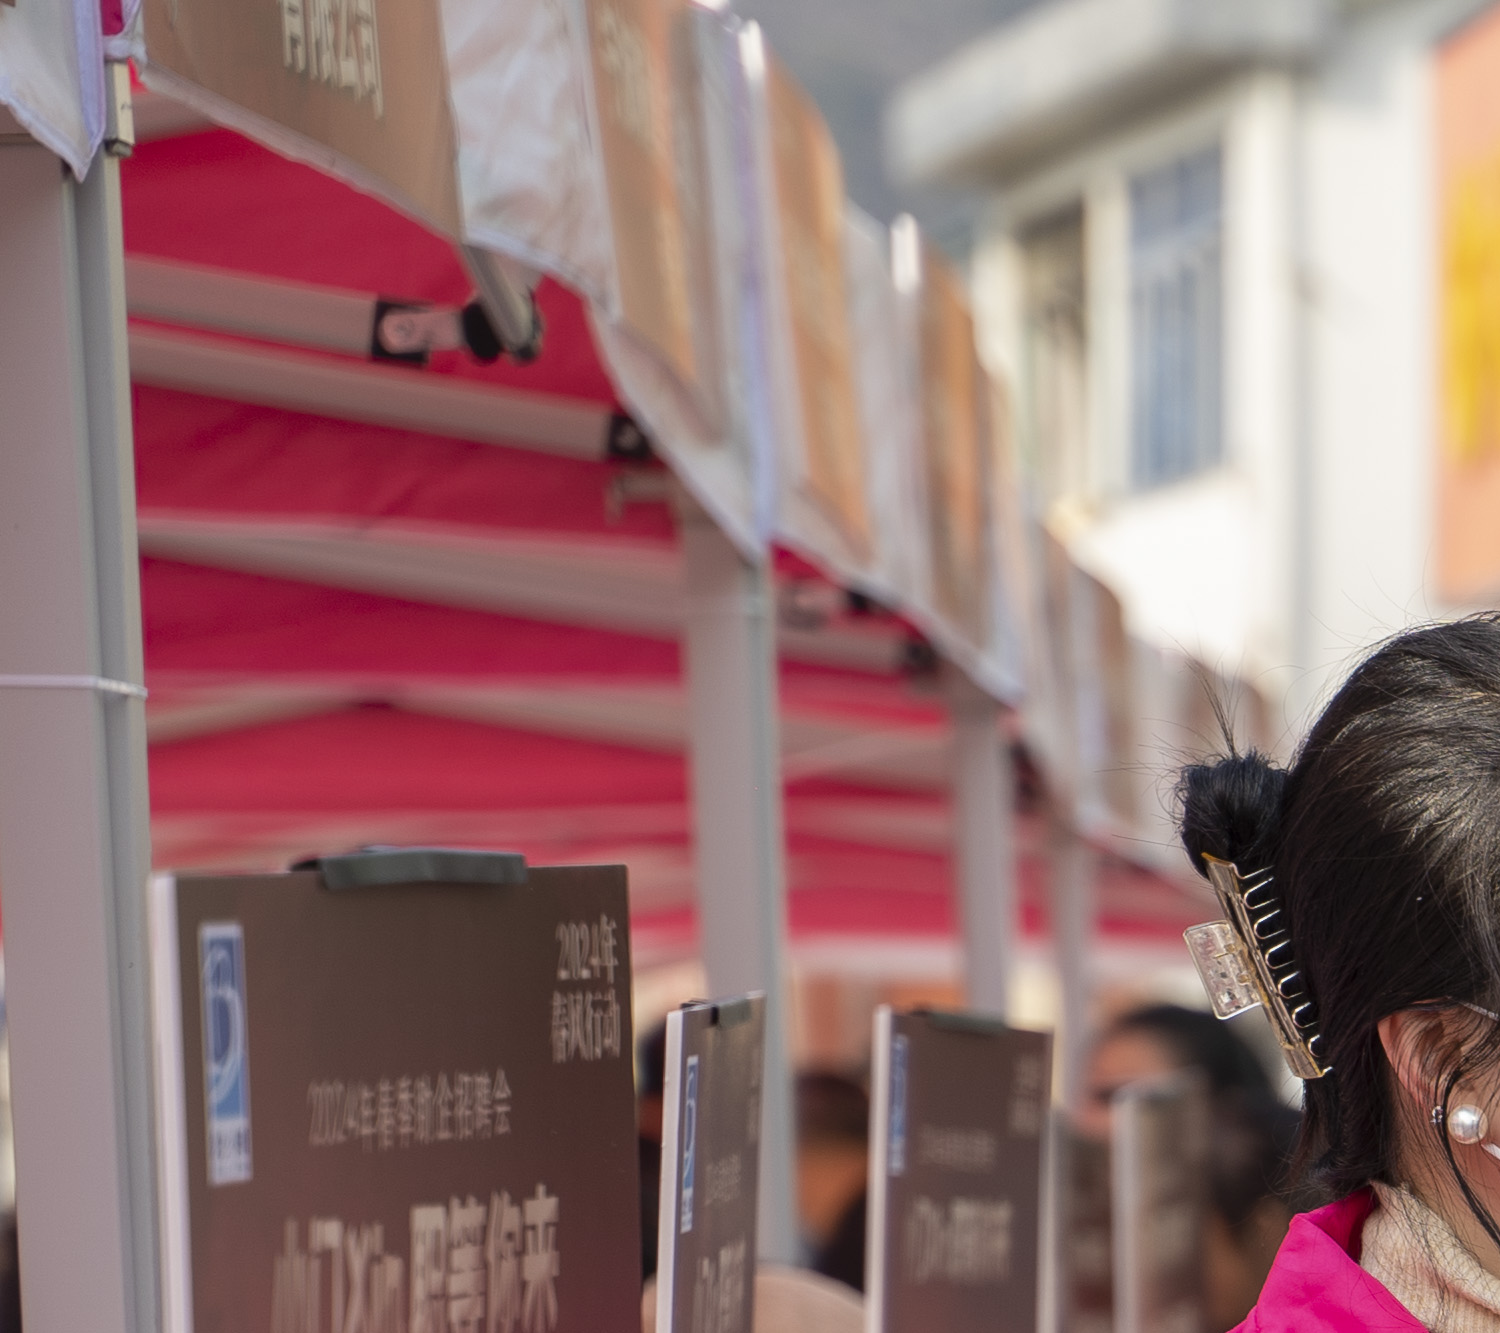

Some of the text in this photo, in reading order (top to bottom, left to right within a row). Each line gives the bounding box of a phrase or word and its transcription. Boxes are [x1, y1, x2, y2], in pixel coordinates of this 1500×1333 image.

[556, 916, 618, 984] 2024年
[551, 988, 622, 1065] 春风行动
[308, 1068, 511, 1156] 2024年春季助企招聘会
